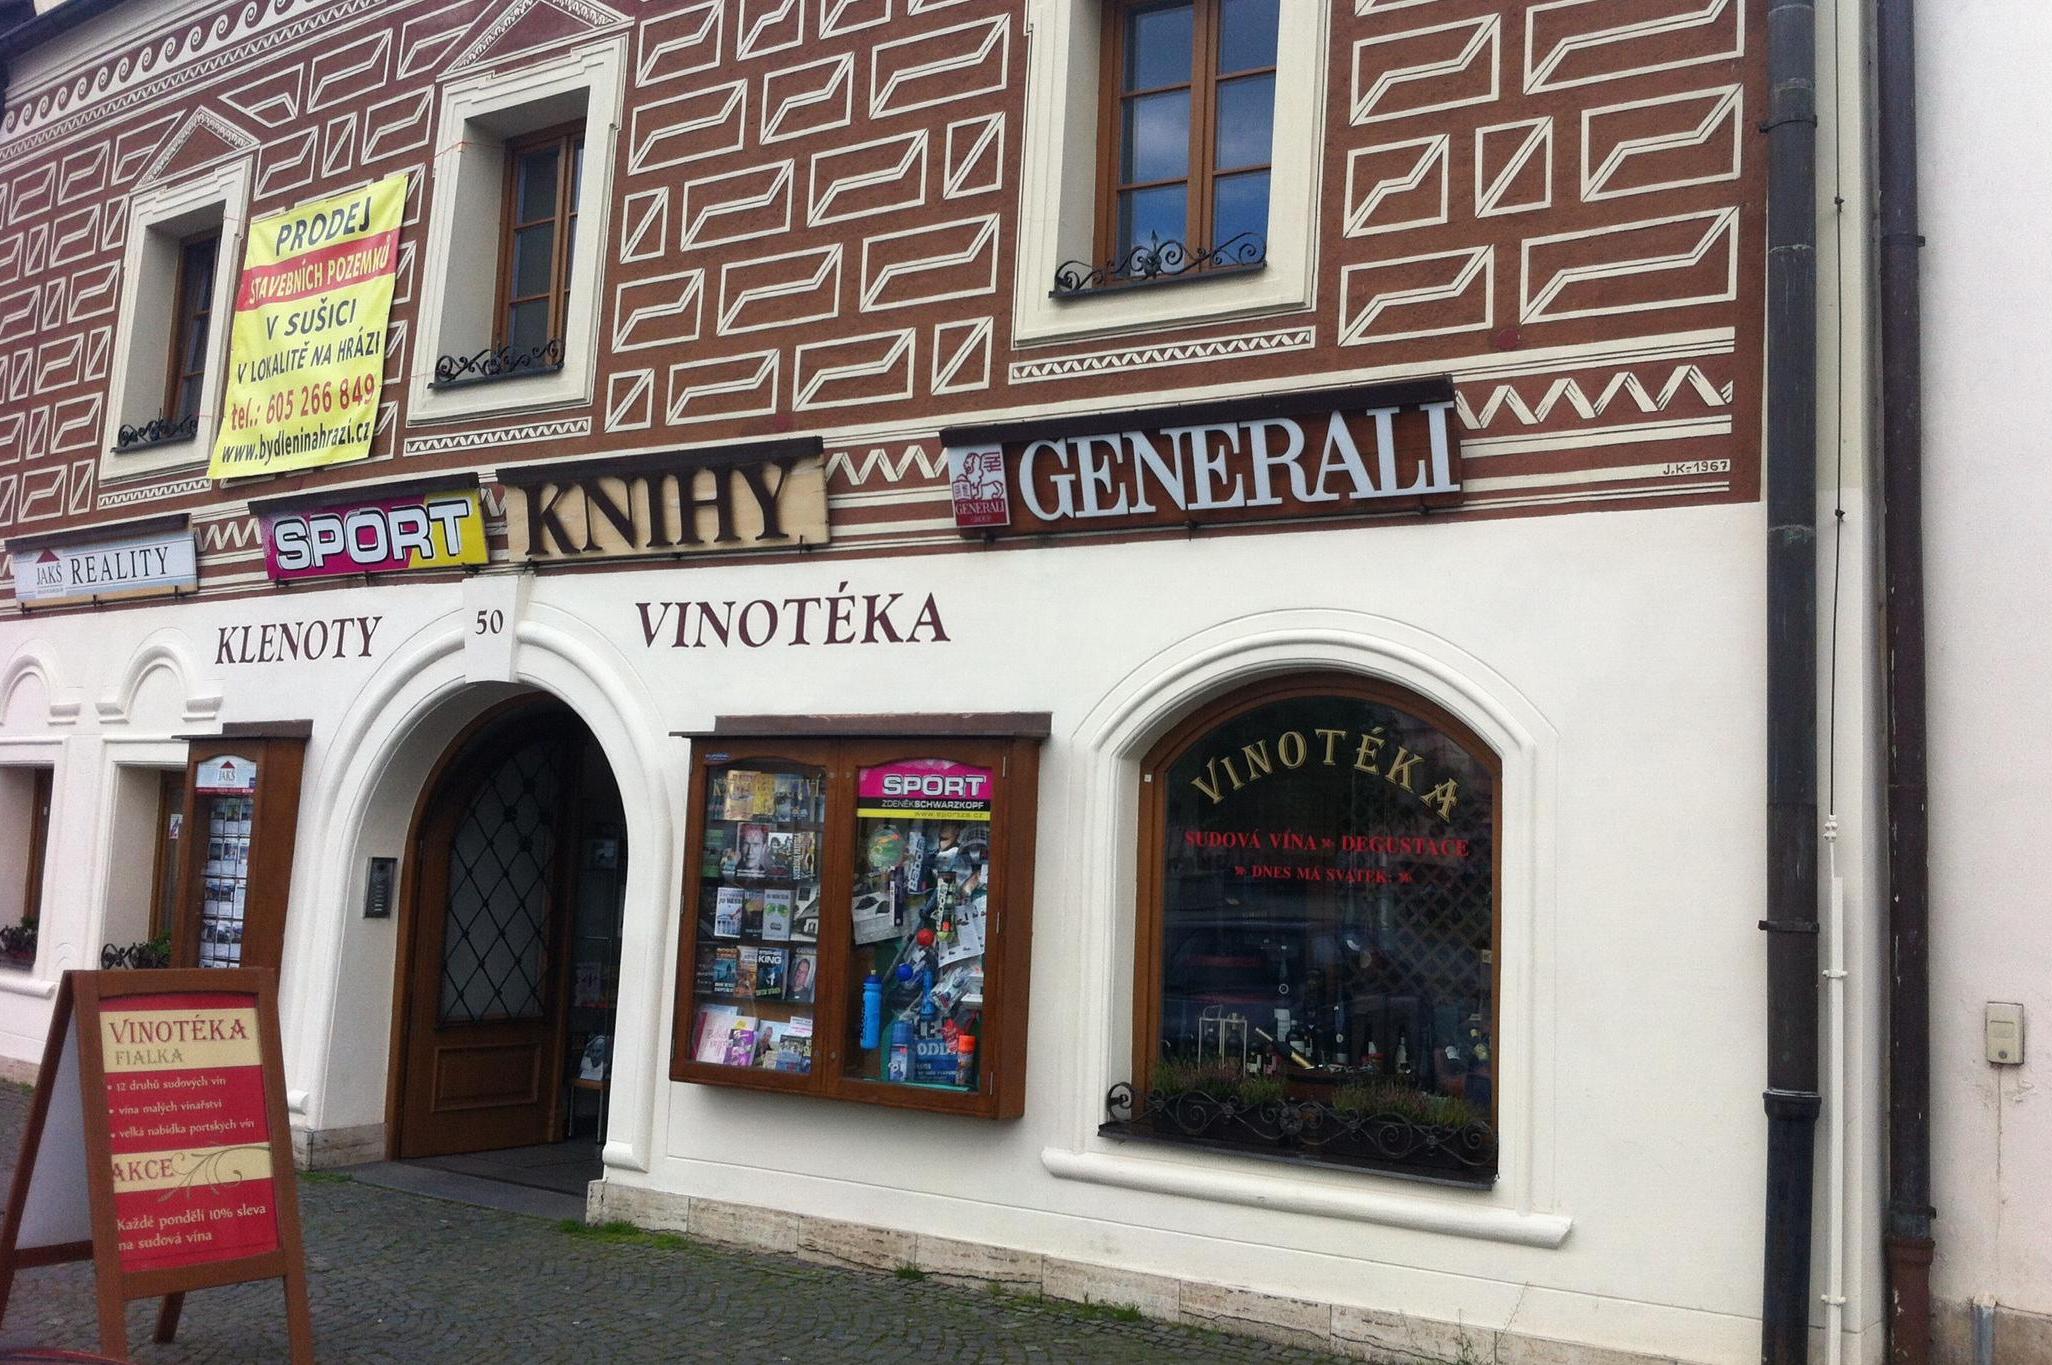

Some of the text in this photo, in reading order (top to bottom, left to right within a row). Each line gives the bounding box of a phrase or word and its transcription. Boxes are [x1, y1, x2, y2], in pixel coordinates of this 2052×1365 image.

[276, 196, 372, 256] PRODEJ
[249, 234, 392, 304] STAVEBNÍCH POZEMKŮ
[266, 297, 356, 340] V SUŠICI
[237, 326, 381, 385] V LOKALITĚ NA HRÁZI
[231, 373, 375, 432] tel.: 605 266 849
[1018, 401, 1461, 522] GENERALI
[525, 461, 796, 555] KNIHY
[955, 501, 1005, 515] GENERALI
[273, 497, 472, 571] SPORT
[36, 546, 169, 586] JAKŠ REALITY
[475, 608, 505, 636] 50
[635, 581, 951, 649] VINOTÉKA
[214, 615, 383, 665] KLENOTY
[882, 773, 986, 797] SPORT
[1191, 726, 1460, 824] VINOTÉKA
[1184, 828, 1470, 857] SUDOVÁ VÍNA DEGUSTACE
[1251, 865, 1291, 879] DNES
[1297, 865, 1321, 881] MÁ
[758, 955, 782, 965] KING
[109, 1014, 247, 1044] VINOTÉKA
[116, 1048, 183, 1066] FIALKA
[116, 1076, 226, 1092] 12 druhů sudových vín
[143, 1101, 178, 1116] malých
[119, 1118, 255, 1139] velká nabídka portských vín
[113, 1158, 175, 1183] AKCE
[117, 1203, 267, 1232] Každé pondělí 10% sleva
[118, 1230, 213, 1252] na sudová vína
